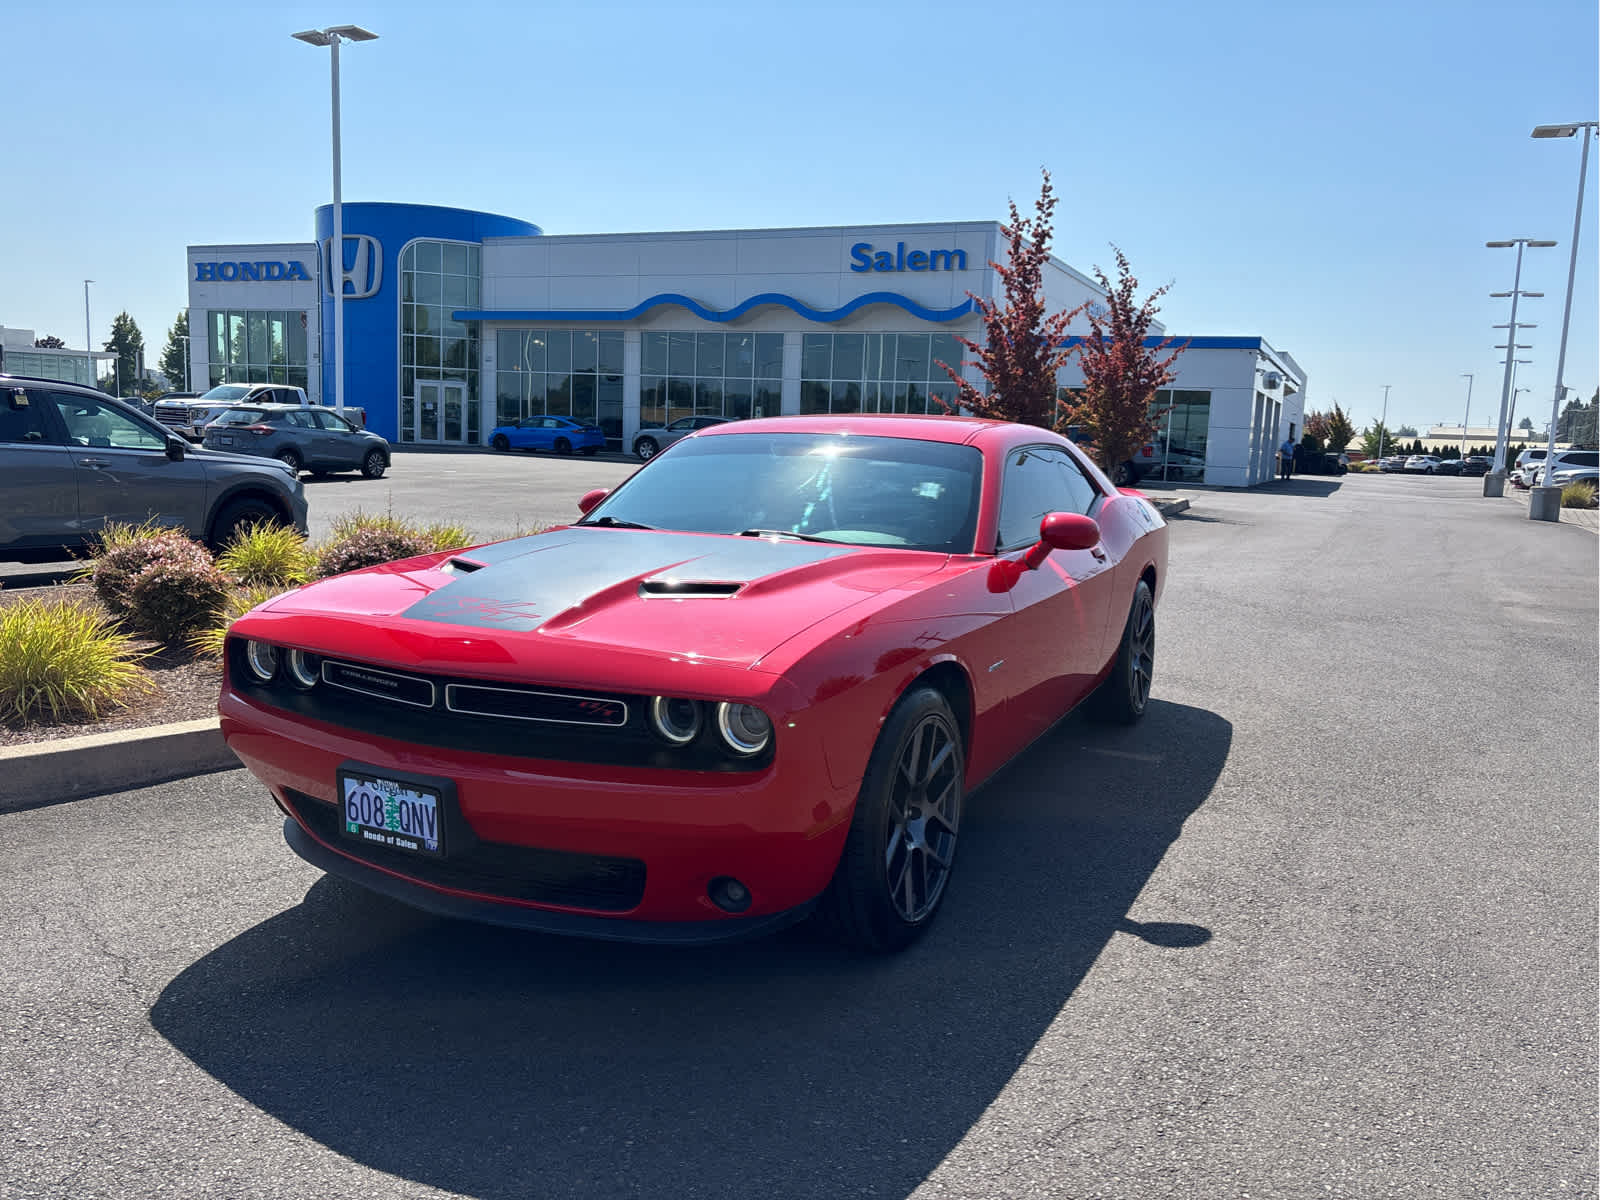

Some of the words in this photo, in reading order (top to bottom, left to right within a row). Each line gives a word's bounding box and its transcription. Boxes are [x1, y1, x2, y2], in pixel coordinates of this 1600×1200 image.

[850, 241, 968, 272] Salem
[194, 261, 313, 281] HONDA
[348, 790, 385, 827] 608
[400, 800, 436, 838] QNV
[363, 830, 385, 842] Honda
[387, 836, 394, 845] of
[395, 837, 418, 850] Salem
